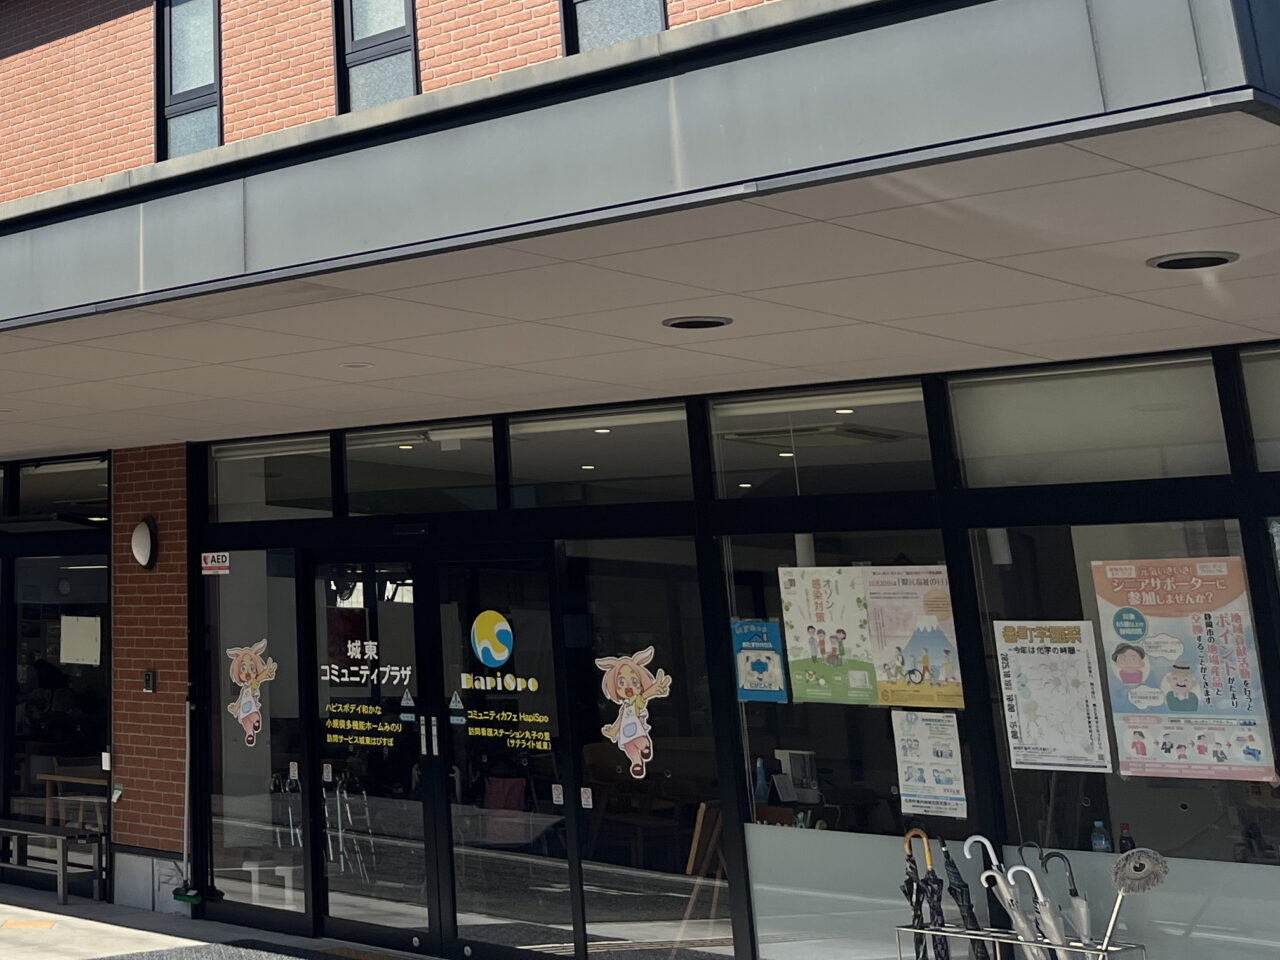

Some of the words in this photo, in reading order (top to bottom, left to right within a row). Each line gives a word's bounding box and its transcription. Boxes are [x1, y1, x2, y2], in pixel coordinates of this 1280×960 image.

[211, 554, 228, 564] AED
[1111, 576, 1227, 592] シニアサポーターに
[812, 578, 825, 623] 感染対策
[347, 639, 379, 660] 城東
[1230, 612, 1254, 712] 地域貢献活動を行うと
[320, 664, 412, 686] コミュニティプラザ
[461, 671, 539, 692] HapiSpo
[467, 709, 518, 722] コミュニティカフェ
[518, 711, 549, 723] HapiSpo
[325, 718, 403, 733] 小規模多機能ホームみのり
[467, 726, 551, 741] 訪問看護ステーション丸子の里
